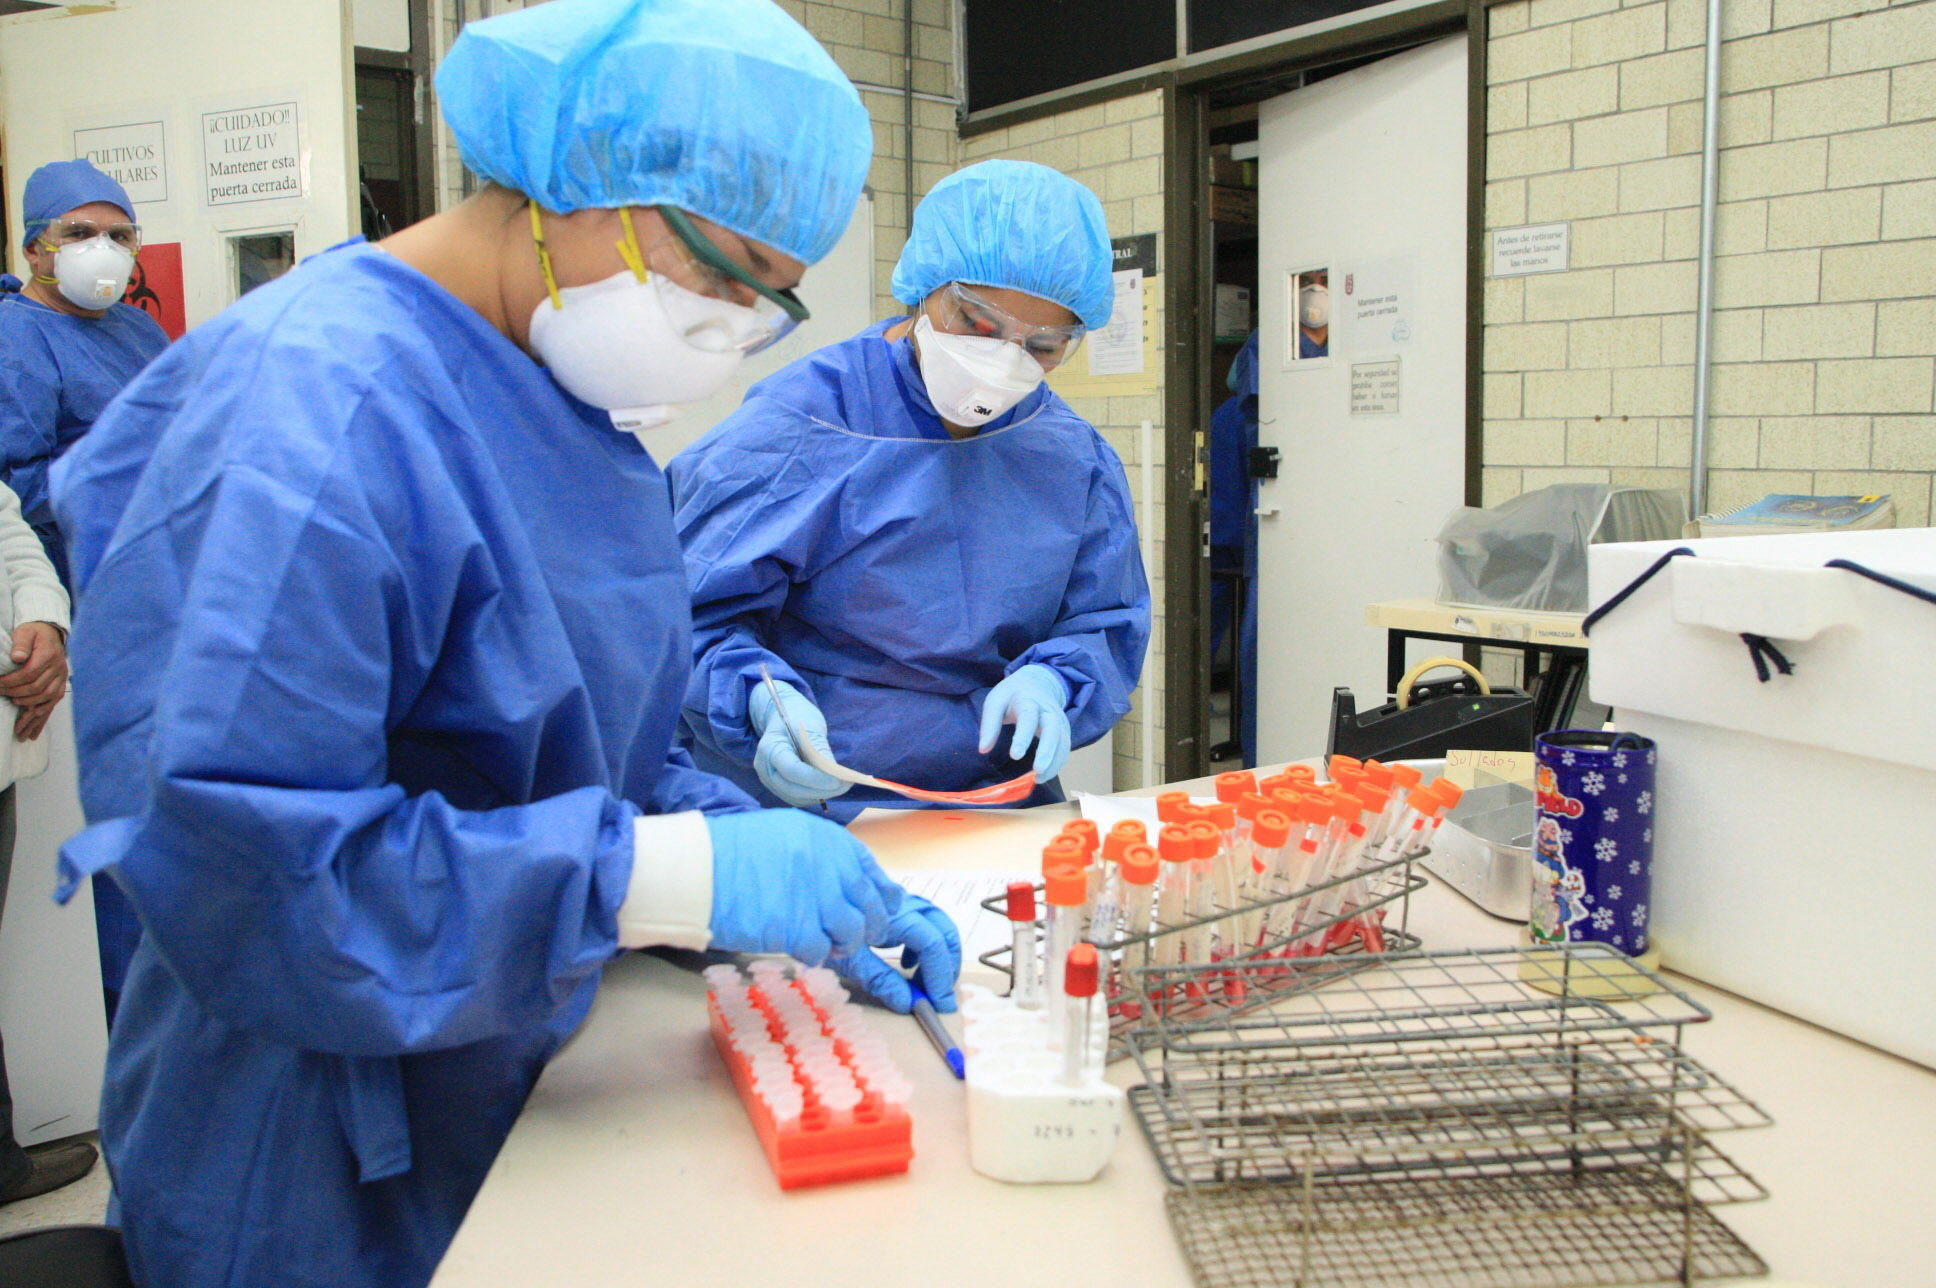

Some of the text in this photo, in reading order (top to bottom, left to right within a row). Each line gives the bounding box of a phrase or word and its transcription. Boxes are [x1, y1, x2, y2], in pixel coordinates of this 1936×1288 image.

[224, 132, 277, 153] LUZ UV
[86, 144, 154, 165] CULTIVOS
[108, 165, 158, 184] ULARES
[209, 156, 295, 177] Mantener esta
[210, 176, 297, 201] puerta cerrada
[1520, 233, 1530, 242] de
[1112, 247, 1132, 259] TRAL
[974, 405, 993, 416] 3M
